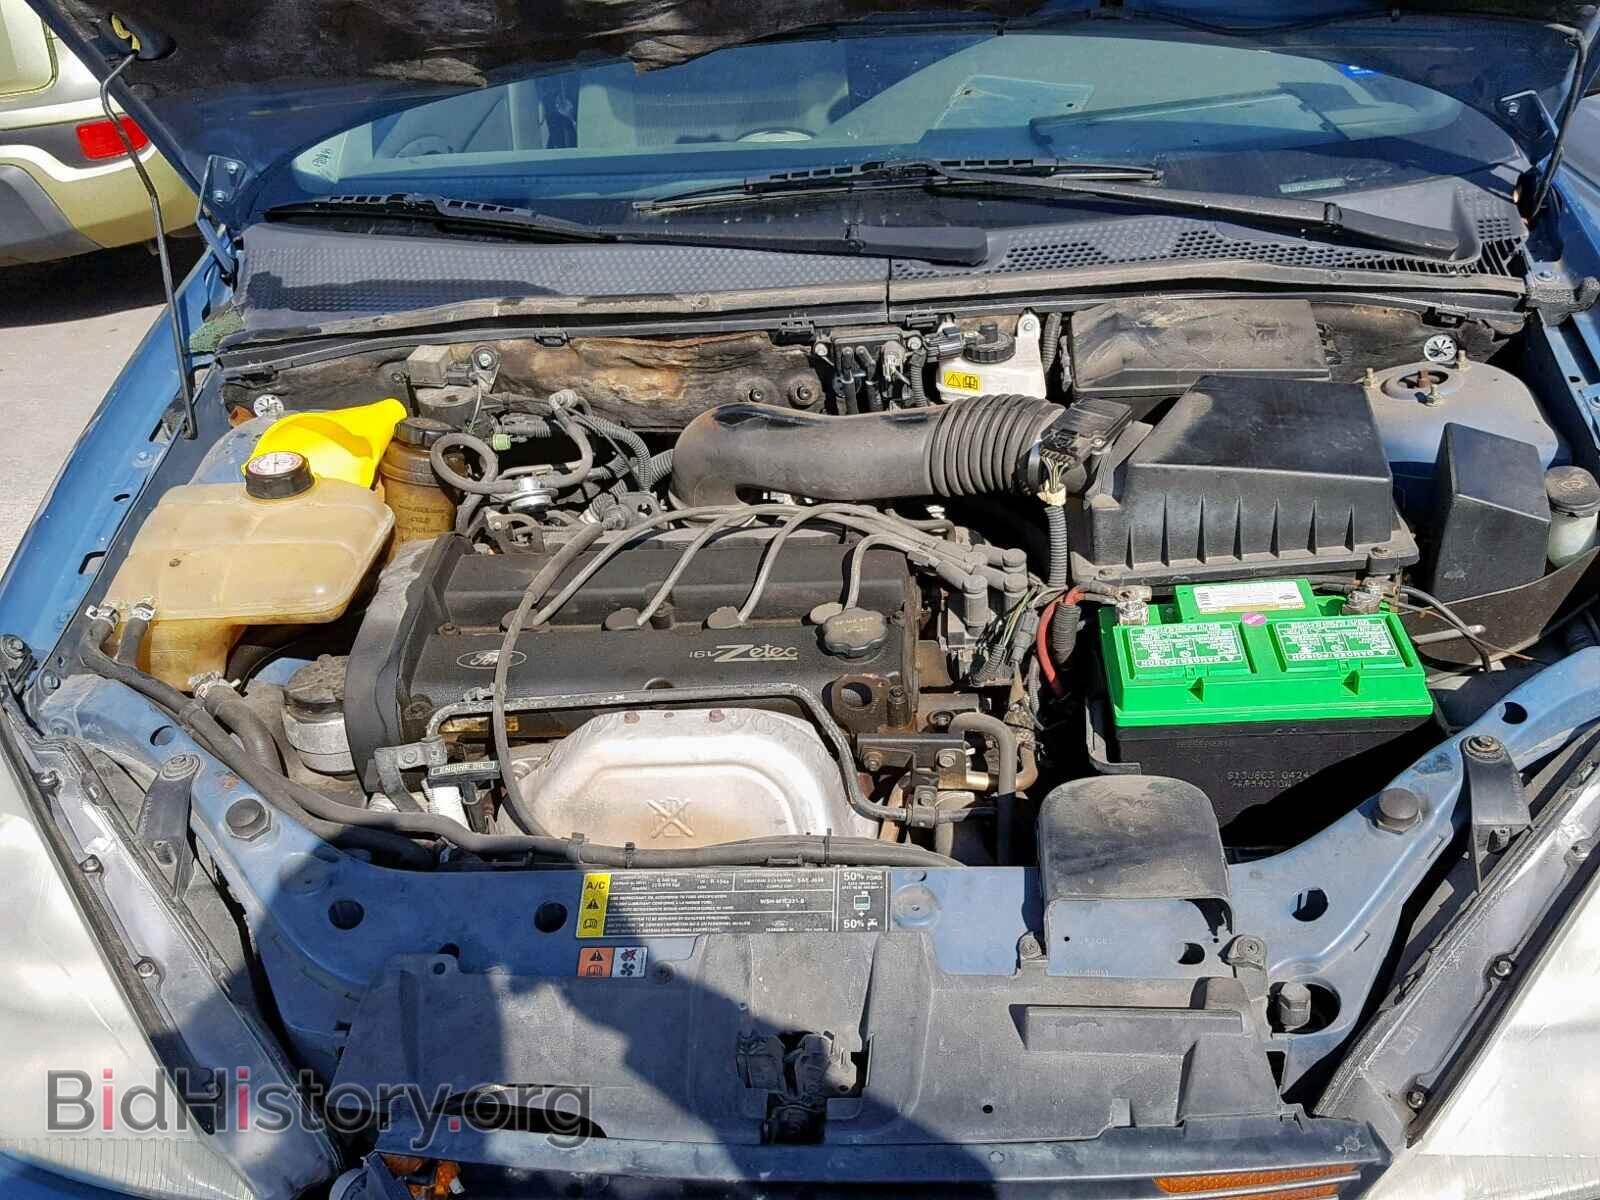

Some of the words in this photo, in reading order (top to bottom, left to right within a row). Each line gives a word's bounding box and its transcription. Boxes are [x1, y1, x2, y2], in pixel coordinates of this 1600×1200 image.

[714, 643, 798, 662] Zetec
[844, 871, 865, 880] 50%
[586, 881, 605, 890] A/C
[844, 919, 864, 928] 50%
